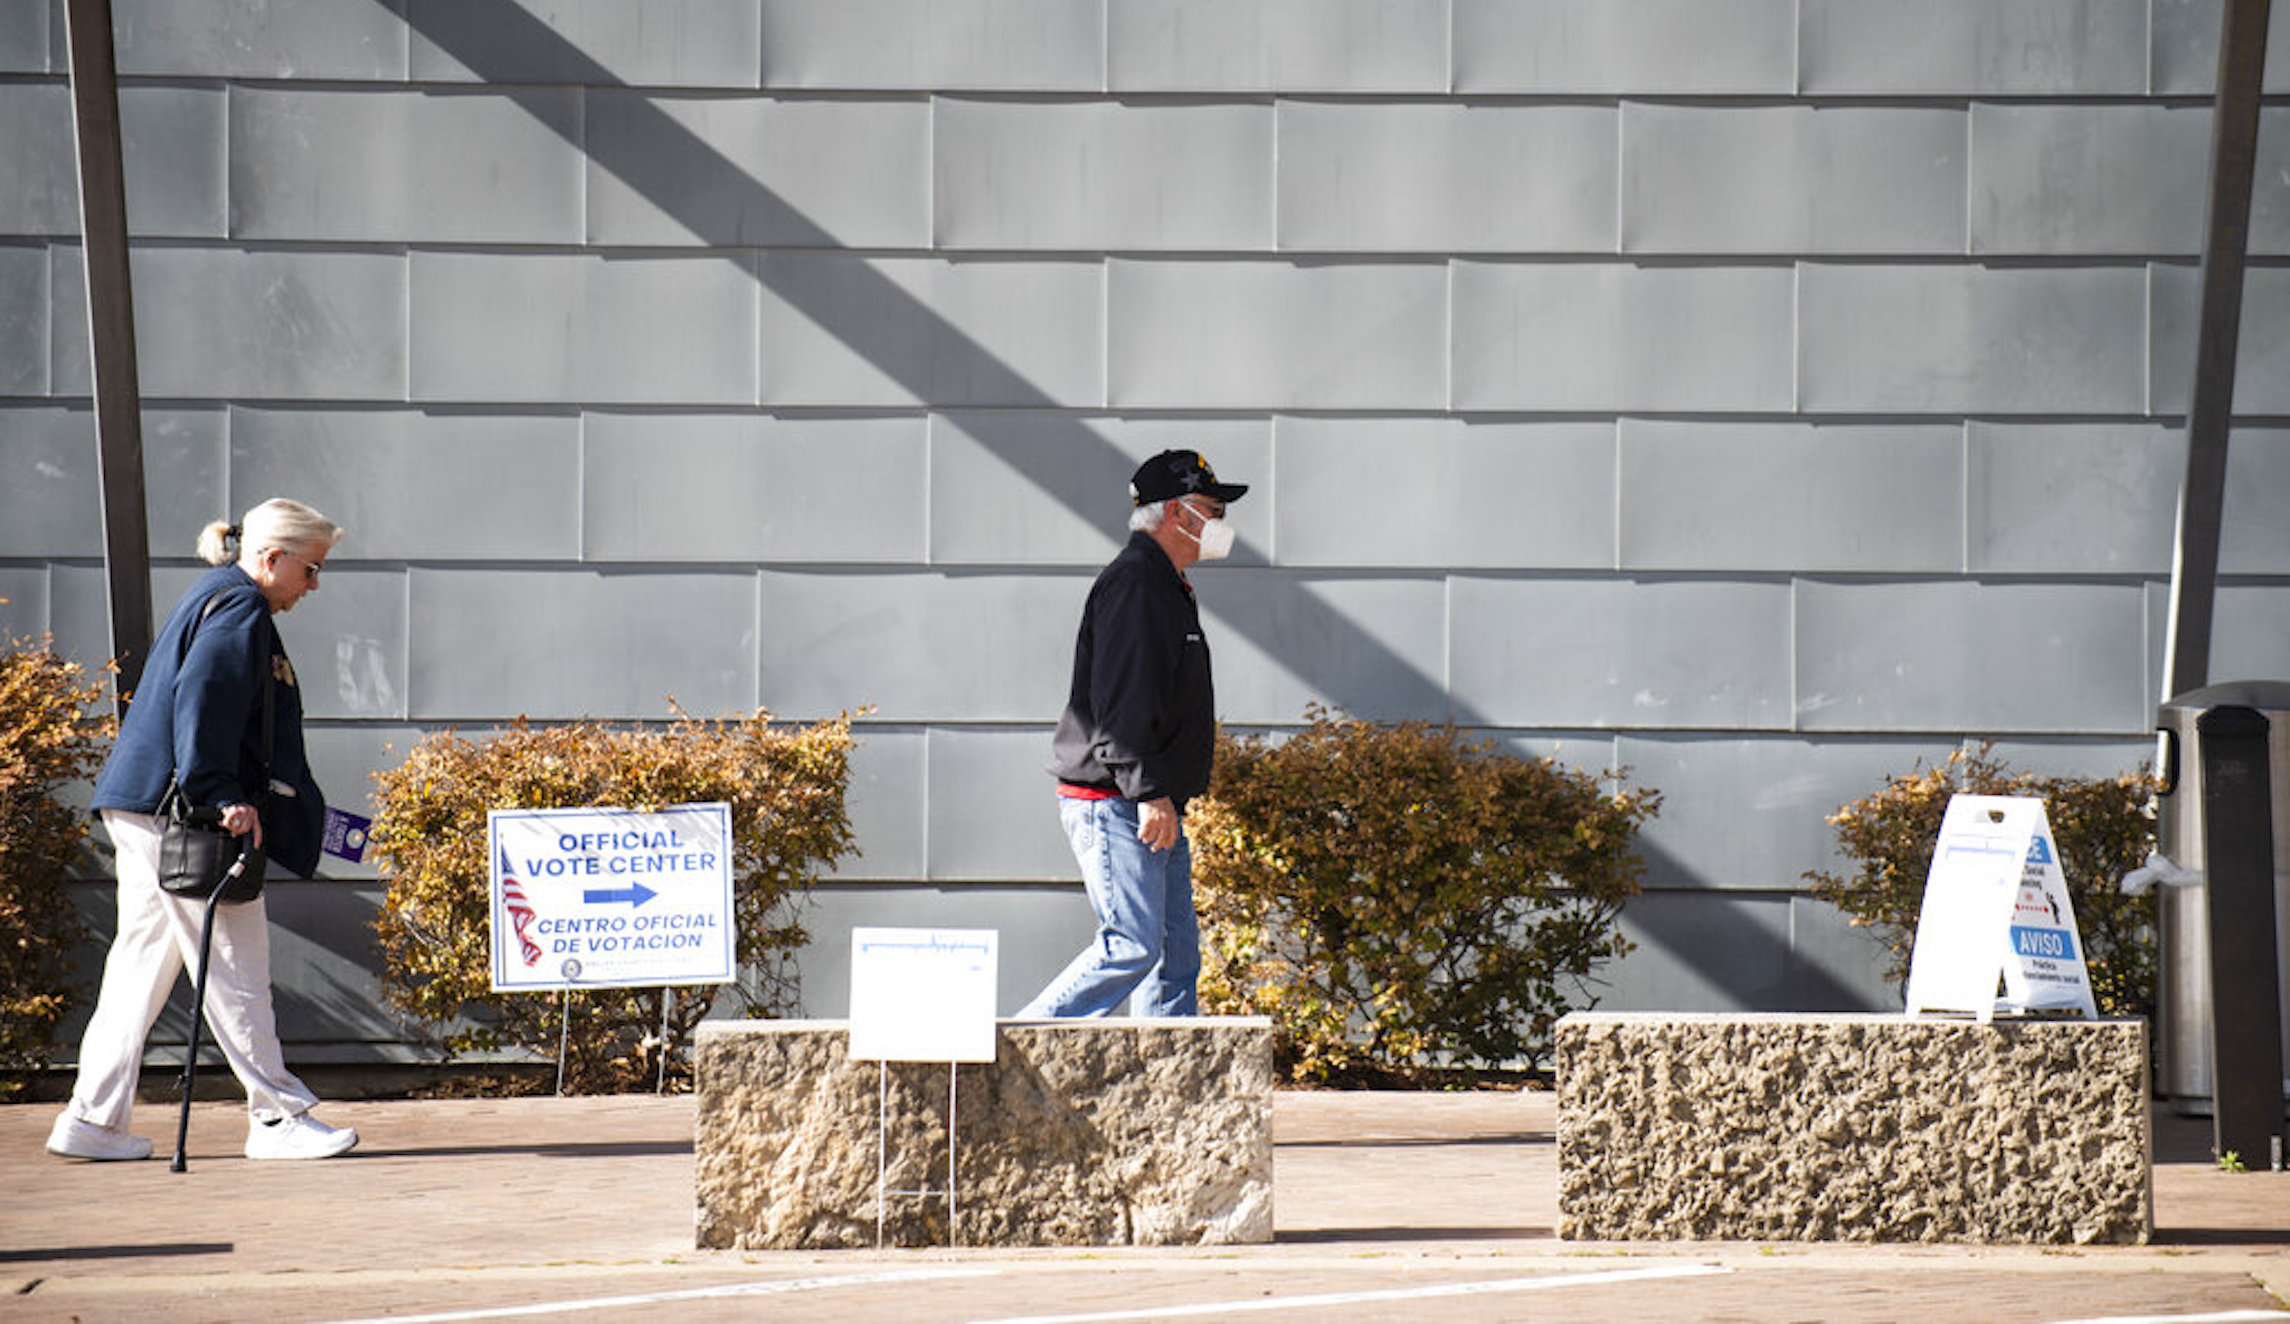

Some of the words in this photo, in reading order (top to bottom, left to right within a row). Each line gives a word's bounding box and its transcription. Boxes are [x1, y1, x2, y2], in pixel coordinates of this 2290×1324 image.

[558, 831, 684, 852] OFFICIAL
[526, 857, 601, 878] VOTE
[608, 851, 717, 875] CENTER
[537, 917, 627, 935] CENTRO
[633, 913, 718, 932] OFICIAL
[553, 938, 581, 954] DE
[2020, 931, 2063, 957] AVISO
